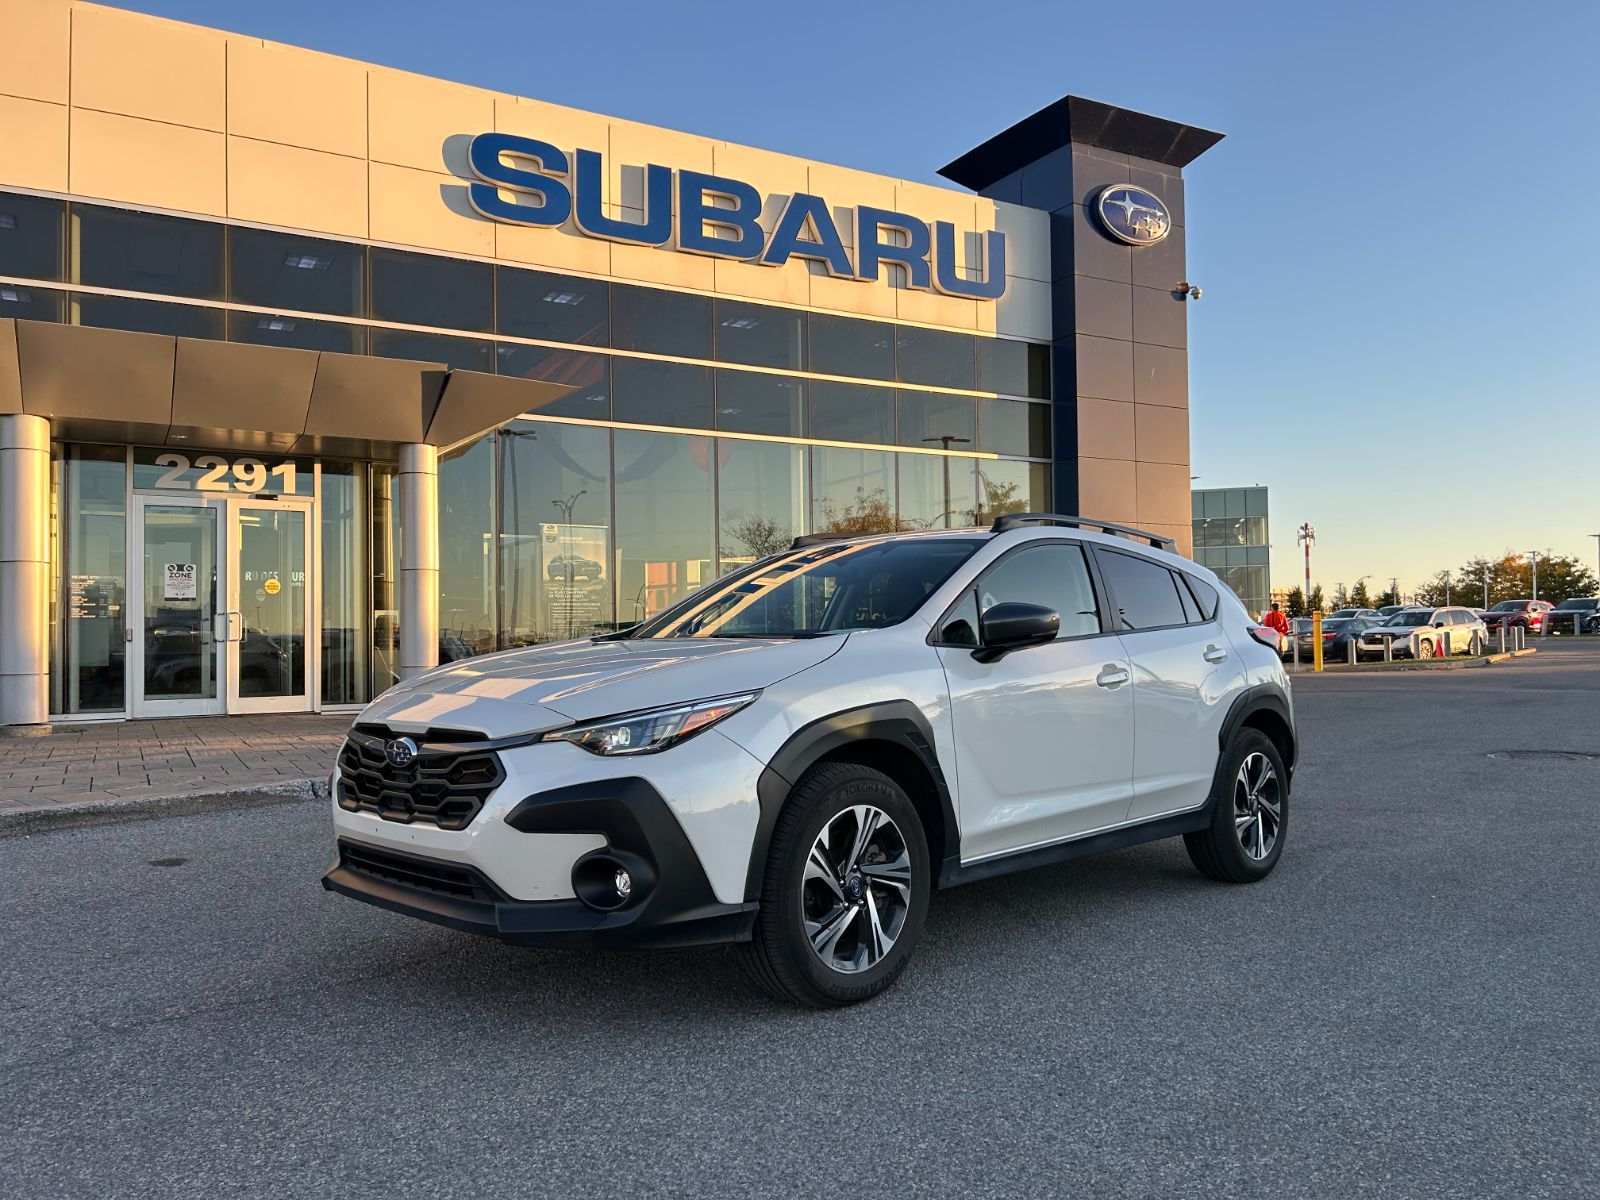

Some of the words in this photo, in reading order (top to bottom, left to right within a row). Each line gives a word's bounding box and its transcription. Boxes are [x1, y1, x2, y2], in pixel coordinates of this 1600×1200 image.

[467, 132, 1006, 301] SUBARU
[155, 453, 296, 494] 2291
[843, 782, 894, 799] YOKOHAMA
